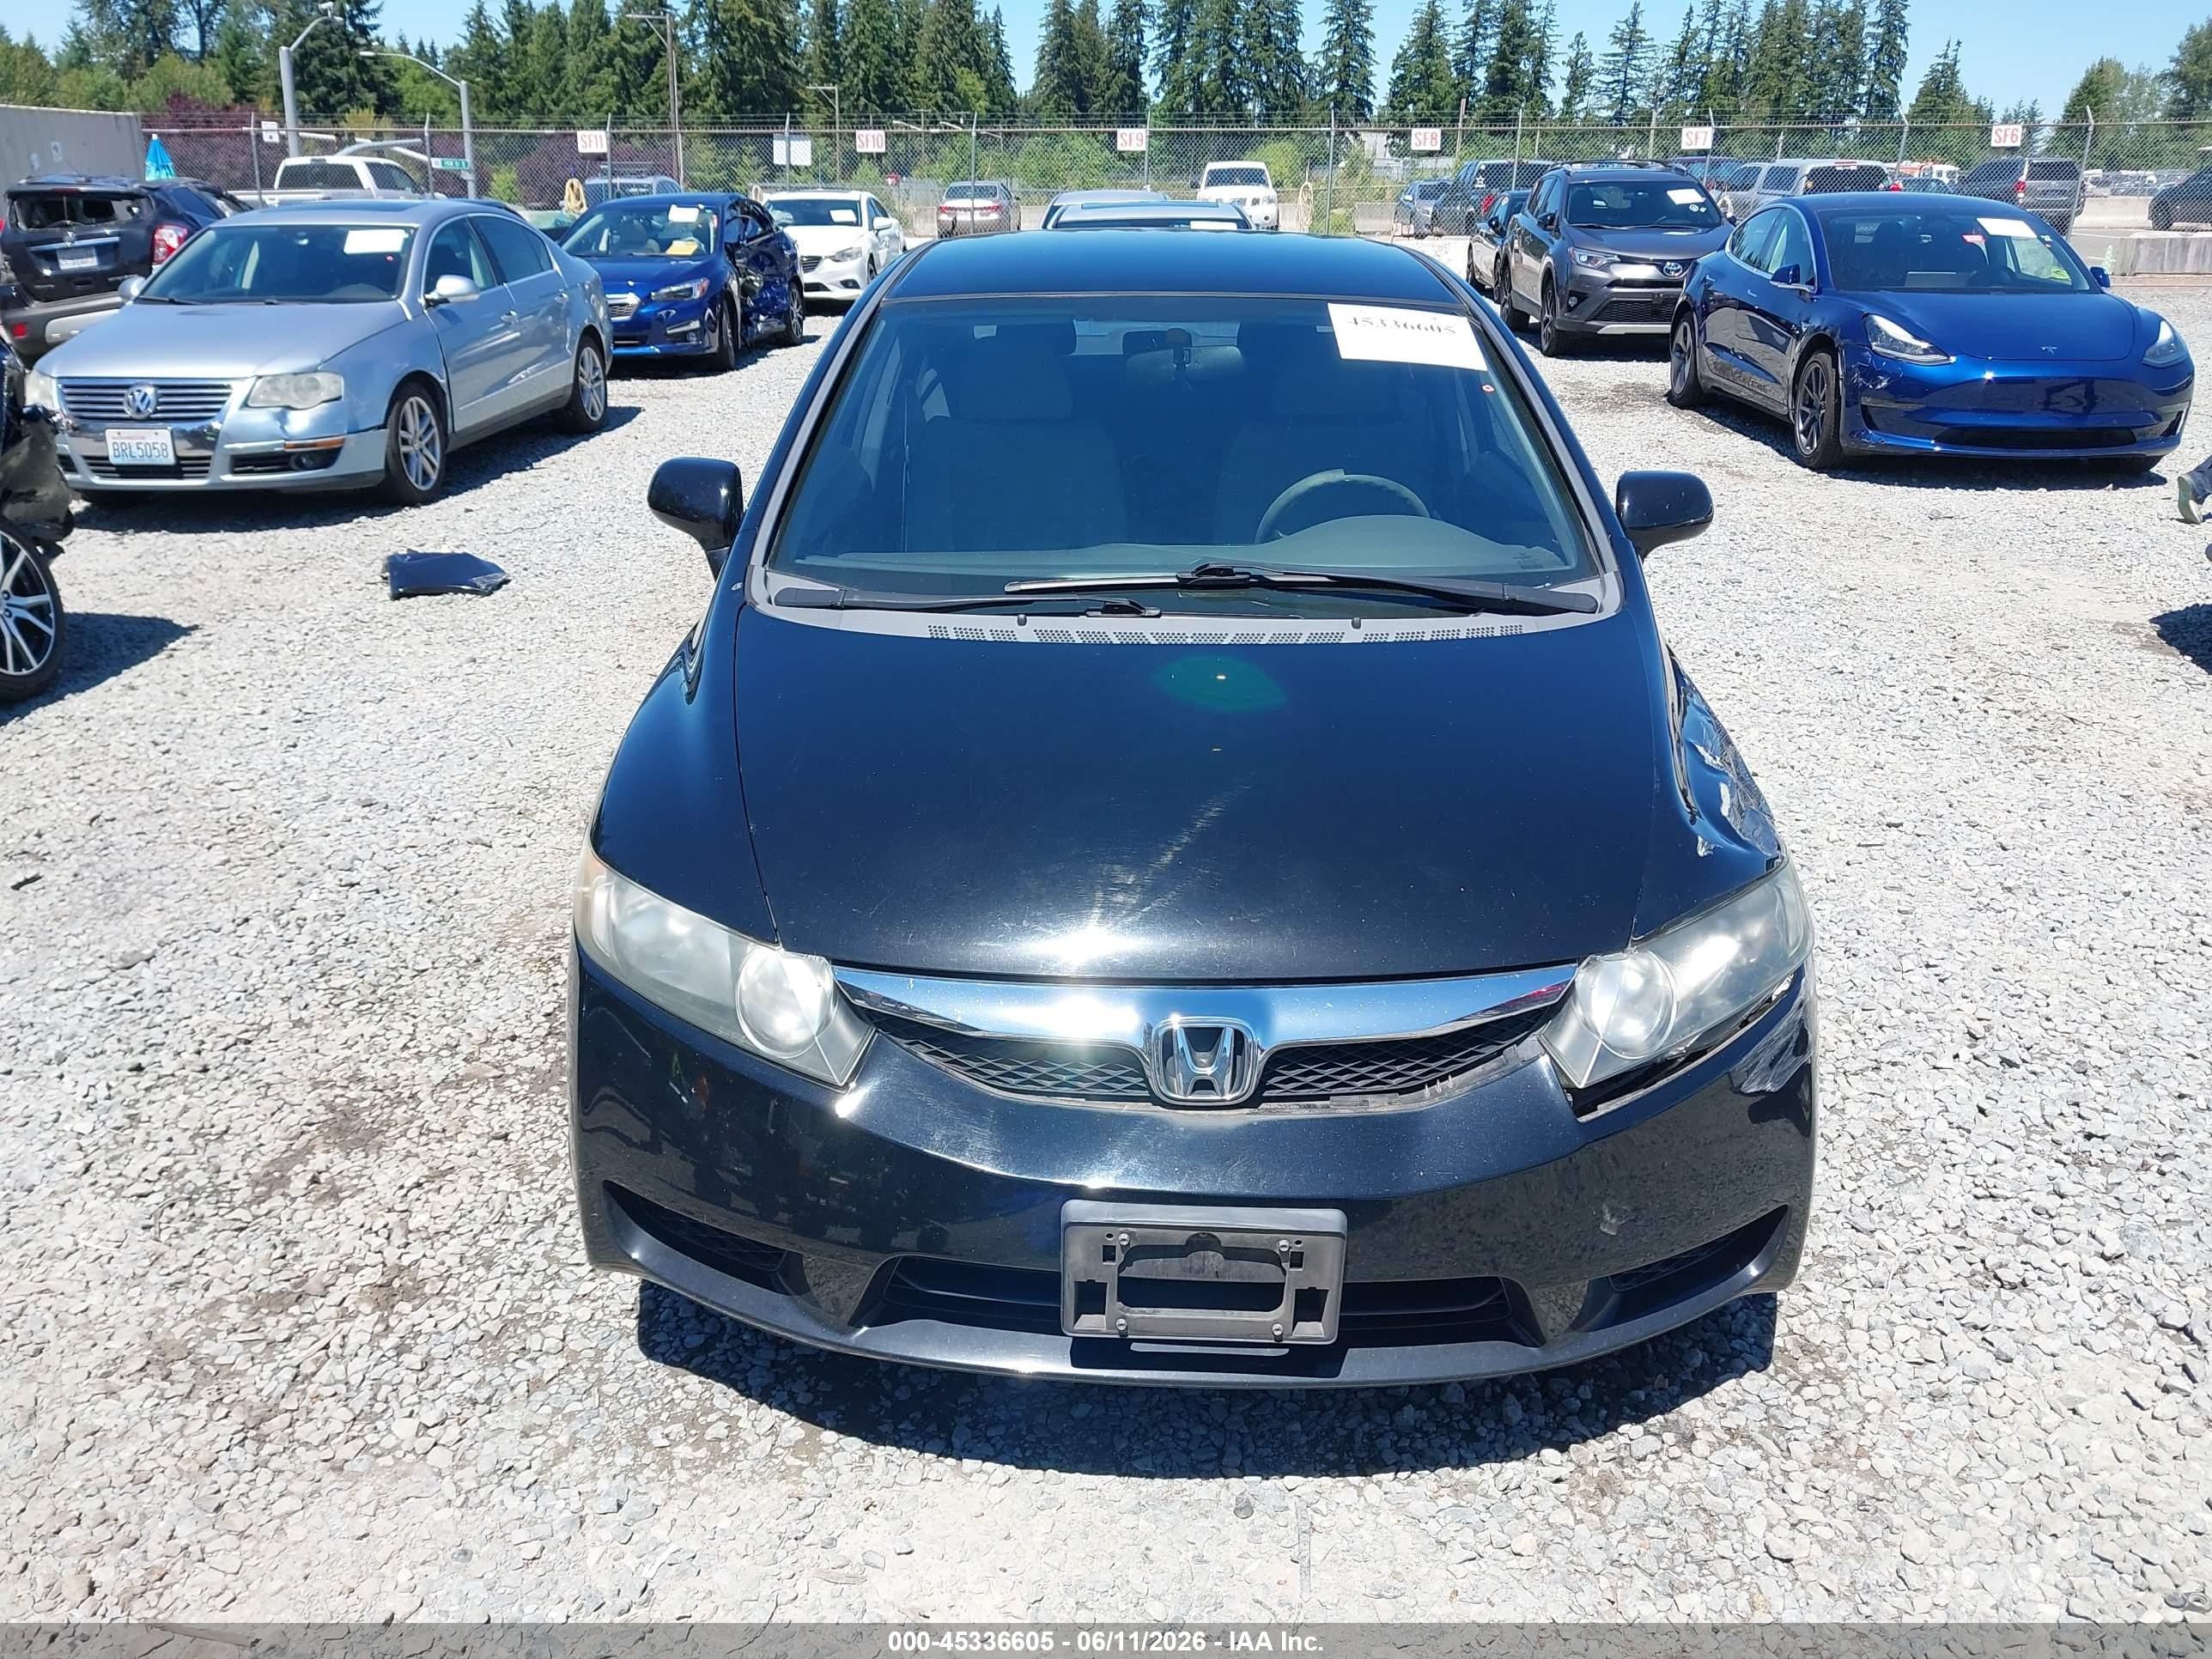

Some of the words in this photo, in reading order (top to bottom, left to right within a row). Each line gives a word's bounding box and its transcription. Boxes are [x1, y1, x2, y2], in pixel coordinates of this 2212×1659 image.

[580, 133, 604, 149] SF11
[858, 133, 884, 149] SF10
[1120, 131, 1144, 147] SF9
[1414, 131, 1438, 147] SF8
[1686, 131, 1708, 146] SF7
[1994, 127, 2019, 144] SF6
[112, 441, 169, 458] BRL5058
